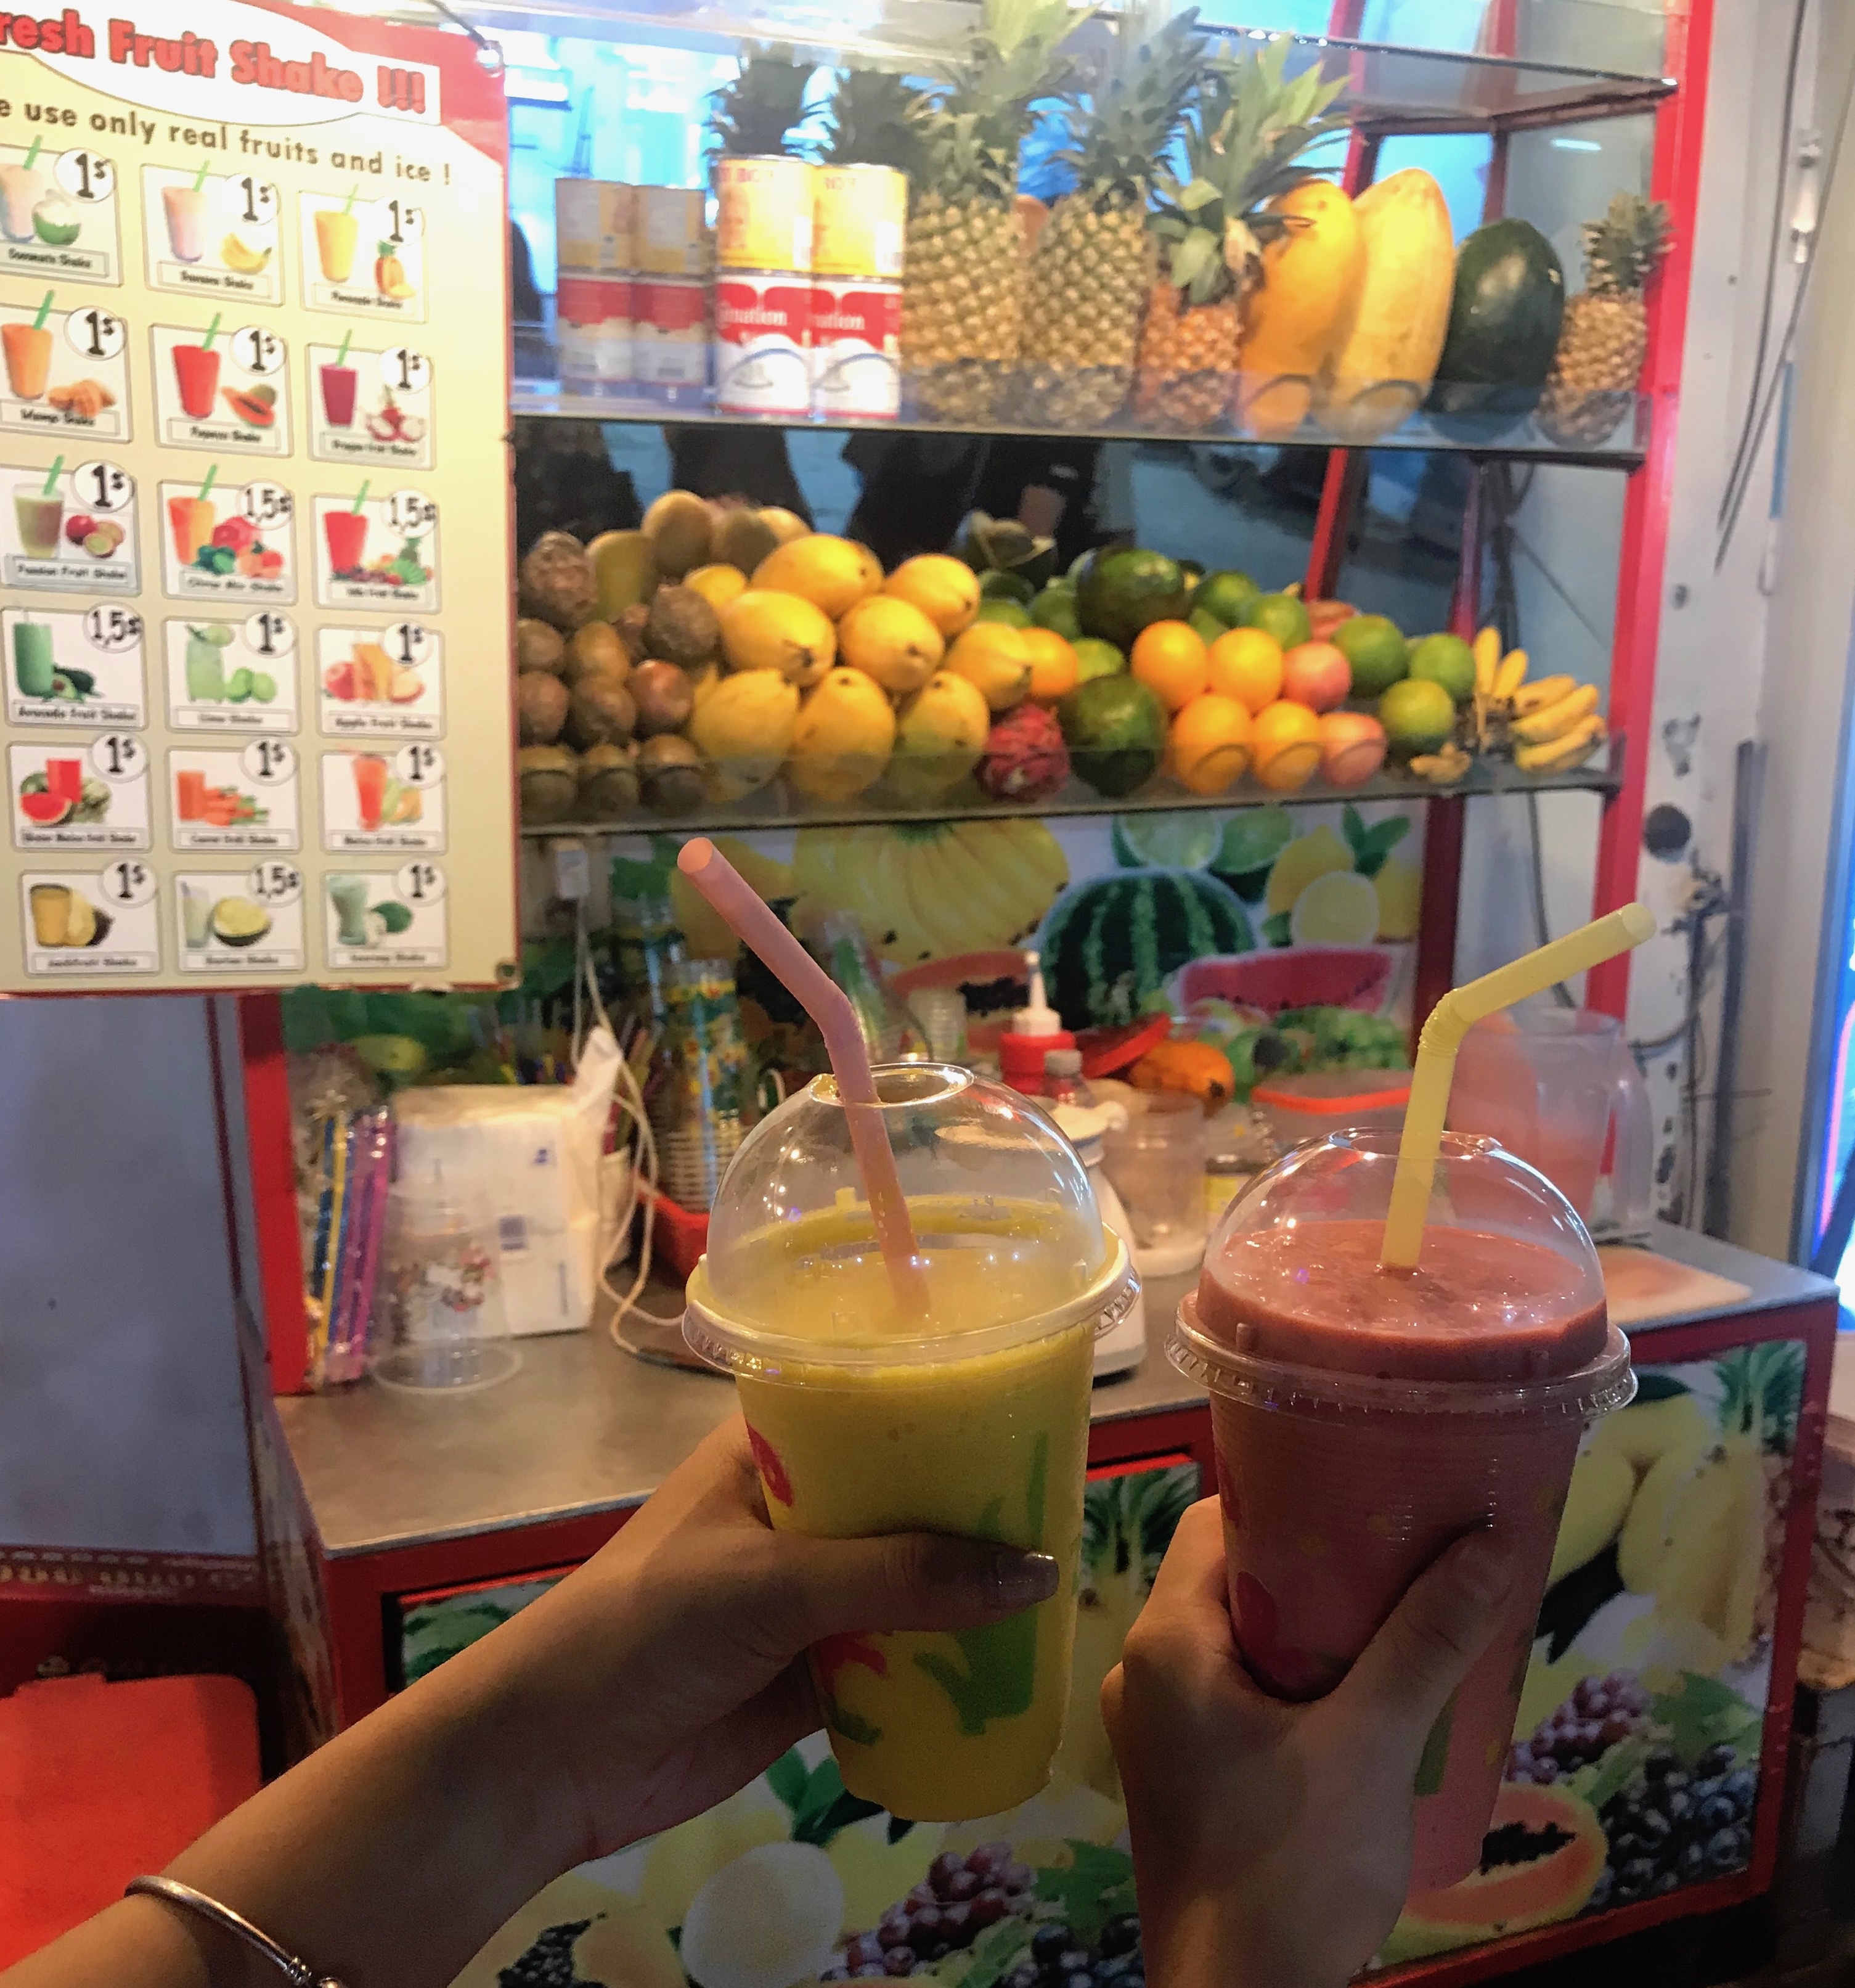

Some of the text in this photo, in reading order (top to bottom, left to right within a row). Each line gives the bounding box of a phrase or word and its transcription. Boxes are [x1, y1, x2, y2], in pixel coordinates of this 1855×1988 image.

[108, 18, 218, 79] Fruit
[229, 39, 364, 102] Shake
[25, 102, 77, 127] use
[89, 110, 155, 145] only
[168, 125, 227, 150] real
[240, 129, 318, 164] fruits
[331, 150, 382, 174] and
[396, 155, 431, 182] ice
